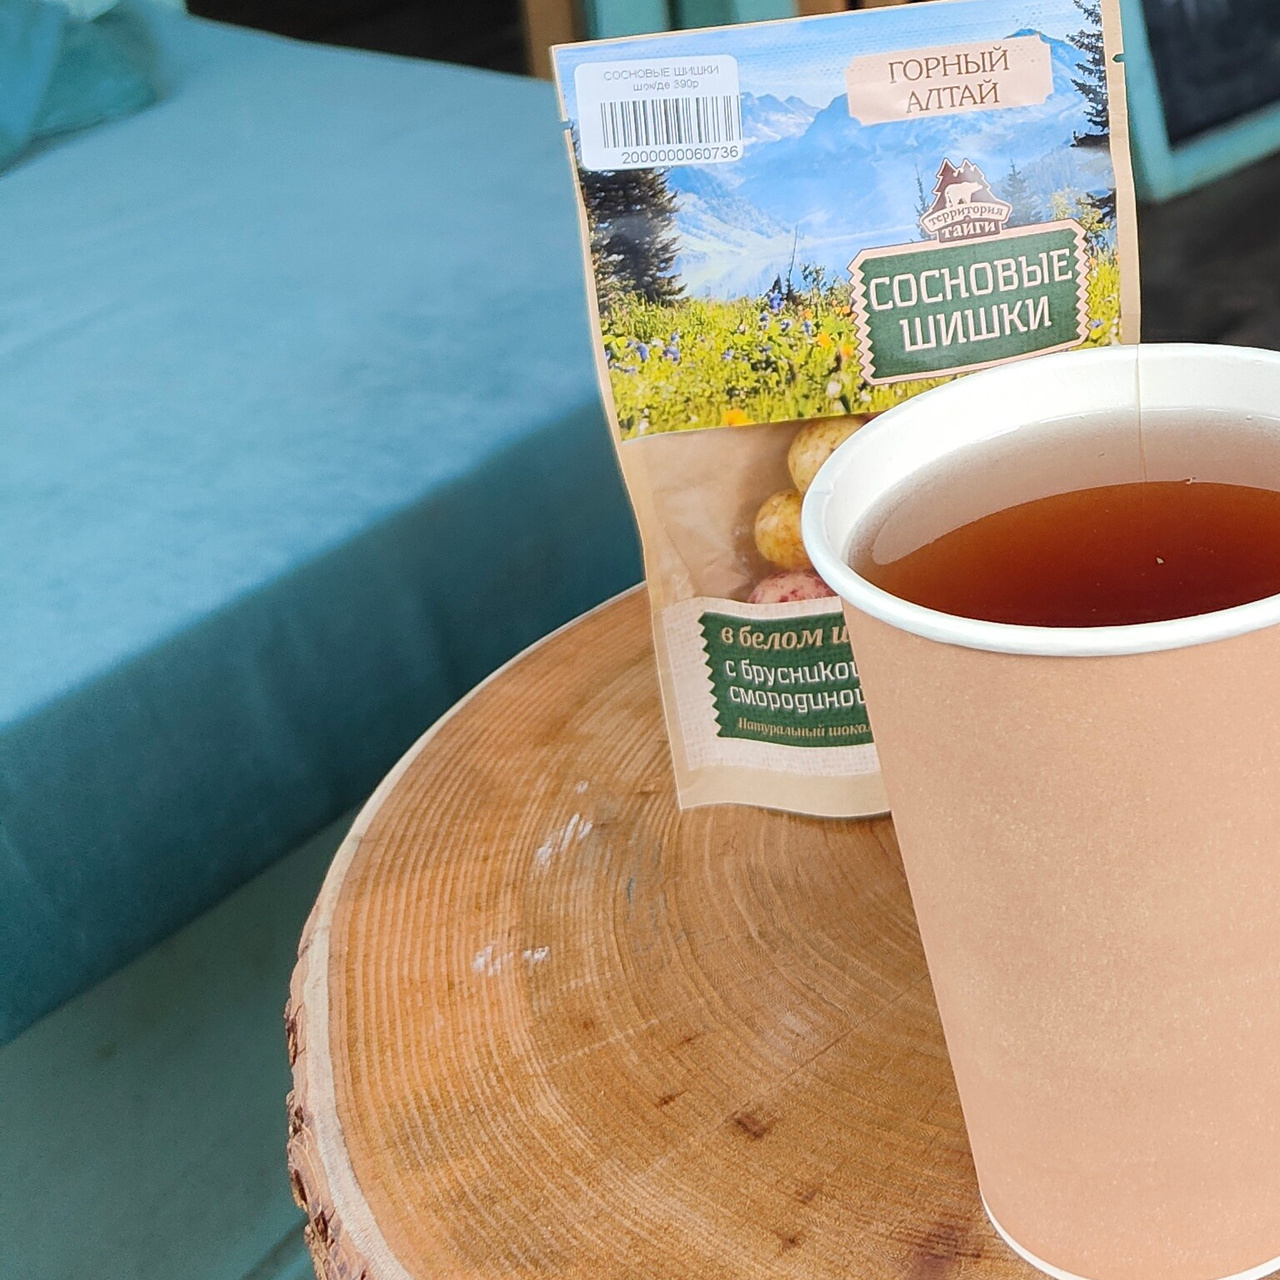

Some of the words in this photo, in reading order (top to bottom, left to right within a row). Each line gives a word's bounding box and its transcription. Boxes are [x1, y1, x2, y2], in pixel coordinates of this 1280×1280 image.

[603, 67, 671, 81] СОСНОВЫЕ
[673, 65, 720, 77] ШИШКИ
[888, 45, 1010, 84] ГОРНЫЙ
[906, 78, 1001, 114] АЛТАЙ
[621, 144, 740, 165] 2000000060736
[928, 204, 1005, 226] территория
[869, 248, 1073, 311] СОСНОВЫЕ
[900, 295, 1053, 352] ШИШКИ
[721, 626, 734, 645] в
[738, 625, 824, 650] белом
[726, 659, 737, 677] с
[737, 716, 826, 738] Натуральный
